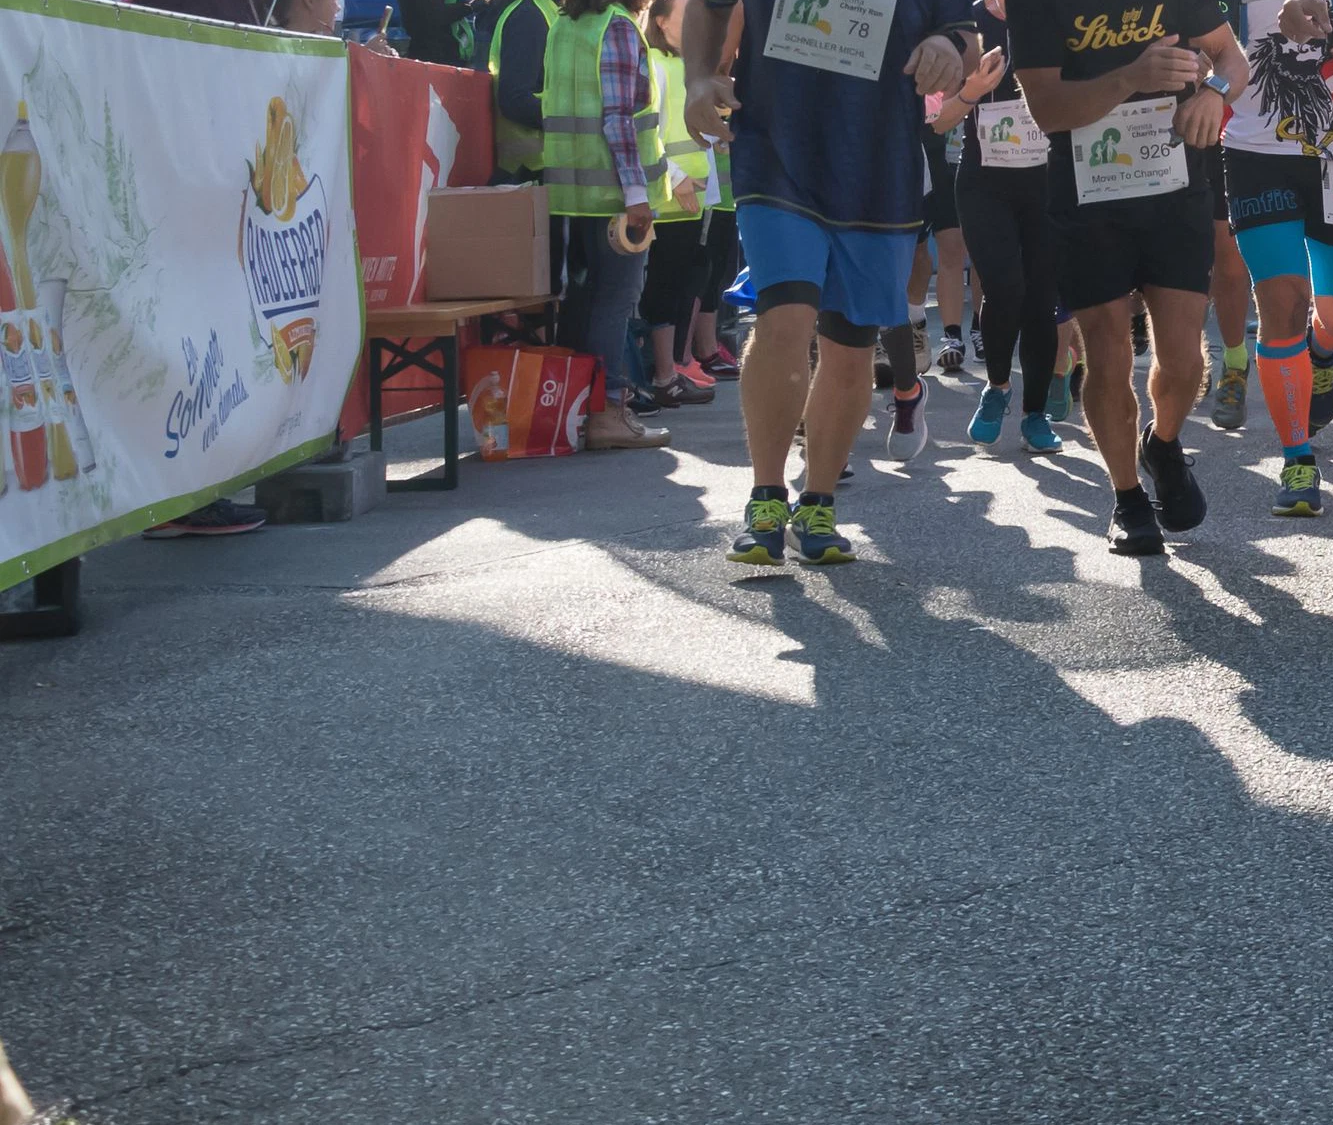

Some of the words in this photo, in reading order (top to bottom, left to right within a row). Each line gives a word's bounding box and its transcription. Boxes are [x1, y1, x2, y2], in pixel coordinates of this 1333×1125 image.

[839, 2, 867, 16] Charity
[848, 19, 870, 39] 78
[1065, 3, 1166, 53] Ströck
[784, 33, 838, 52] SCHNELLER
[1131, 129, 1158, 139] Charity
[1139, 142, 1171, 161] 926
[1091, 174, 1118, 185] Move
[1119, 171, 1132, 181] To
[1133, 165, 1173, 179] Change!
[164, 327, 224, 459] Sommer
